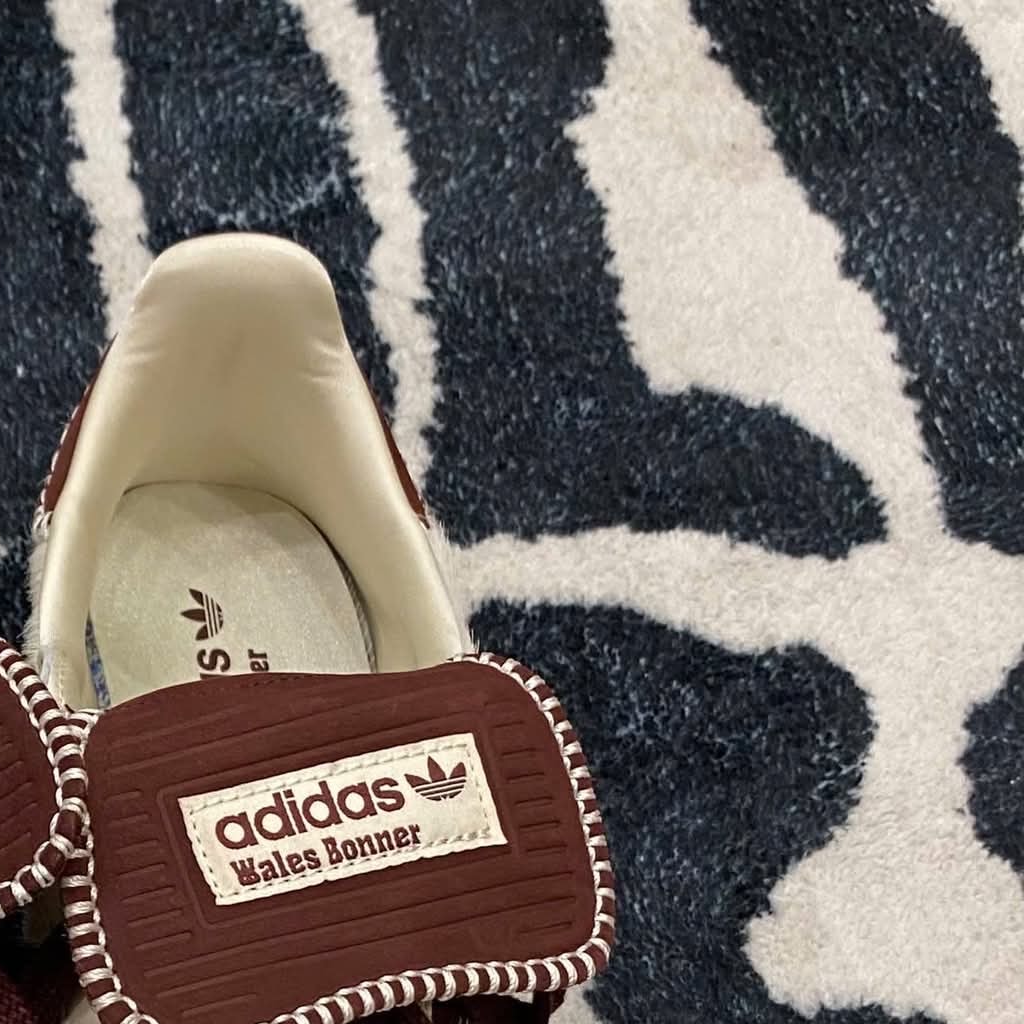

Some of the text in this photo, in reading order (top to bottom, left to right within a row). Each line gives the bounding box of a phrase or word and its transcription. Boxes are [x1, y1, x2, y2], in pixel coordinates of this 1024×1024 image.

[214, 776, 406, 850] adidas
[229, 822, 422, 887] Wales Bonner
